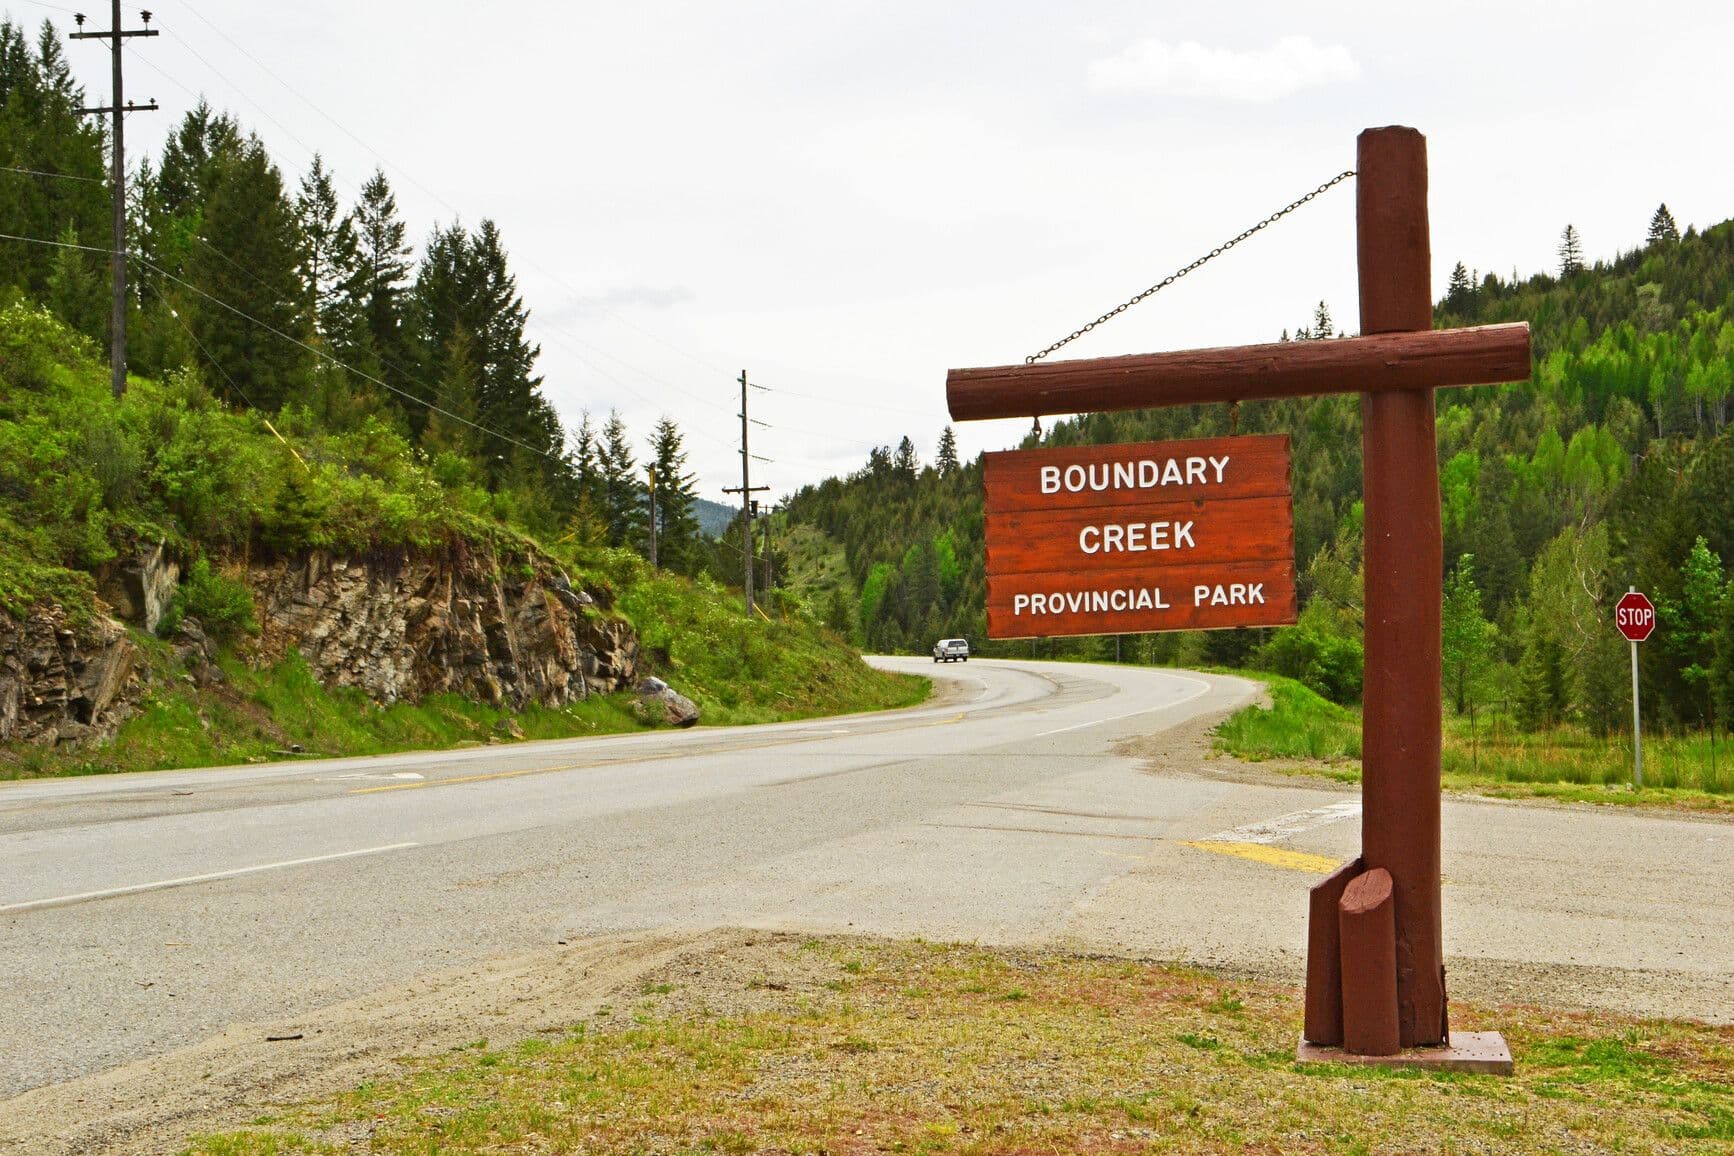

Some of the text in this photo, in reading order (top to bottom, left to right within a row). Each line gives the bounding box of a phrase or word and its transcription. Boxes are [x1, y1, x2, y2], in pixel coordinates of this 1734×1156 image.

[1040, 455, 1230, 494] BOUNDARY
[1079, 521, 1195, 554] CREEK
[1014, 583, 1265, 615] PROVINCIAL PARK
[1619, 608, 1652, 626] STOP
